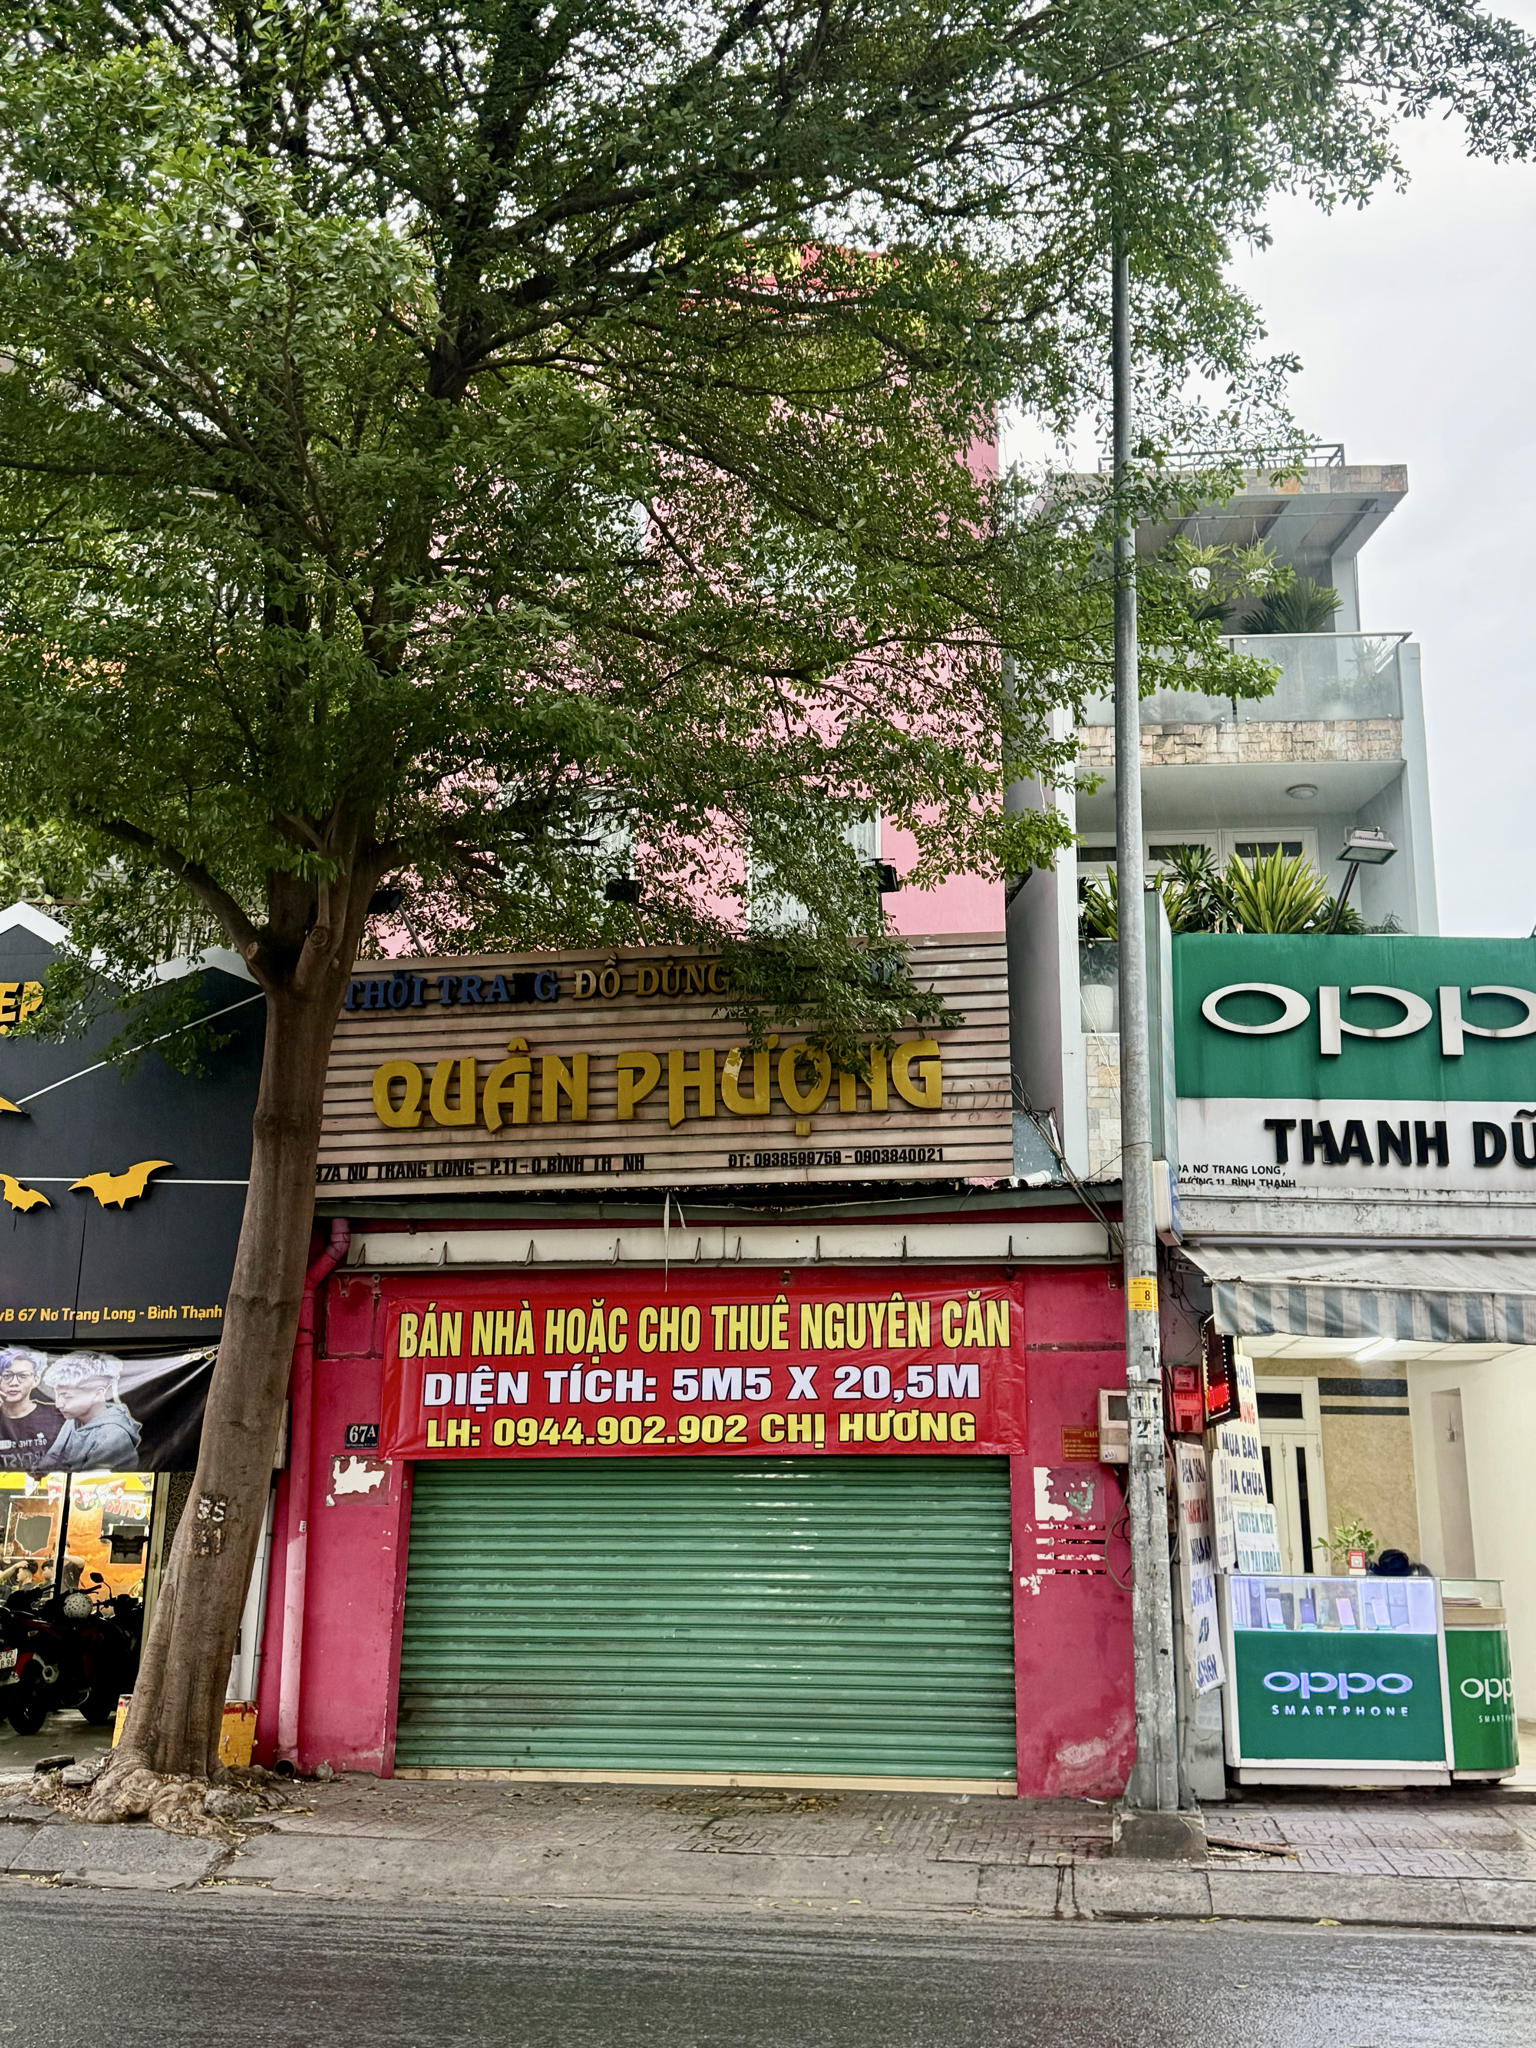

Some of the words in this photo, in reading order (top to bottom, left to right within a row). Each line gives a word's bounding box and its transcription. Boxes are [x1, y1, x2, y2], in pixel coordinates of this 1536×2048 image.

[371, 1037, 589, 1134] QUÂN
[1264, 1118, 1450, 1165] THANH
[728, 1153, 750, 1168] ĐT:
[1193, 1164, 1209, 1173] NƠ
[1212, 1165, 1248, 1174] TRANG
[377, 1161, 427, 1181] TRANG
[1144, 1290, 1151, 1301] 8
[17, 1308, 37, 1321] 67
[40, 1308, 59, 1321] Nơ
[62, 1307, 100, 1324] Trang
[103, 1306, 136, 1323] Long
[147, 1305, 178, 1320] Bình
[181, 1304, 222, 1321] Thạnh
[398, 1302, 463, 1358] BÁN
[470, 1299, 536, 1356] NHÀ
[544, 1297, 629, 1364] HOẶC
[637, 1305, 702, 1353] CHO
[710, 1293, 790, 1351] THUÊ
[800, 1291, 931, 1350] NGUYÊN
[941, 1289, 1010, 1348] CĂN
[424, 1364, 530, 1413] DIỆN
[543, 1362, 657, 1404] TÍCH:
[672, 1366, 772, 1402] 5M5
[786, 1365, 819, 1400] X
[833, 1363, 980, 1404] 20,5M
[349, 1425, 376, 1443] 67A
[426, 1417, 481, 1448] LH:
[492, 1413, 749, 1447] 0944.902.902
[760, 1412, 826, 1449] CHỊ
[838, 1409, 977, 1444] HƯƠNG
[1263, 1671, 1413, 1700] oppo
[1271, 1704, 1409, 1717] SMARTPHONE
